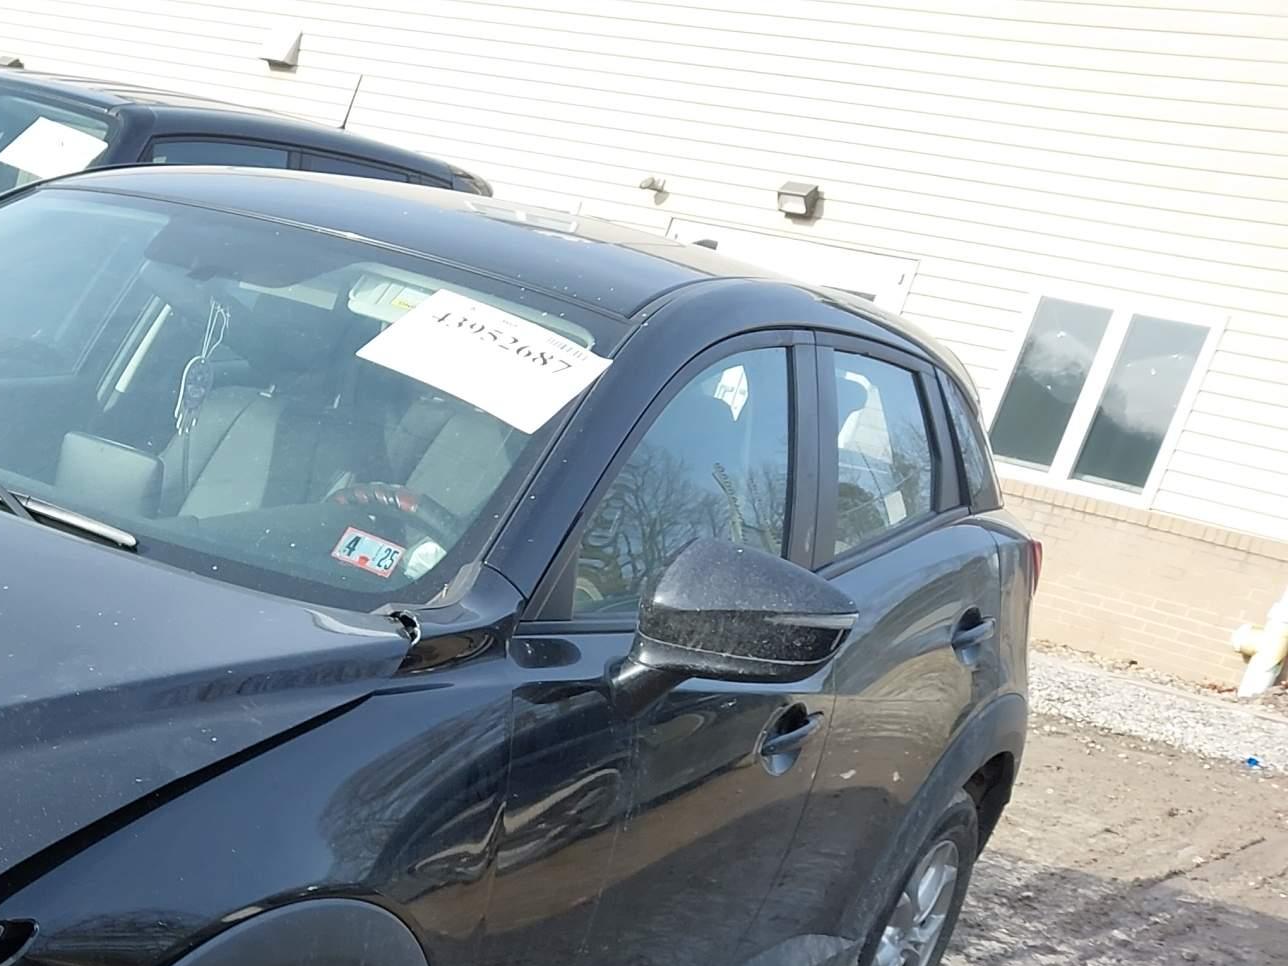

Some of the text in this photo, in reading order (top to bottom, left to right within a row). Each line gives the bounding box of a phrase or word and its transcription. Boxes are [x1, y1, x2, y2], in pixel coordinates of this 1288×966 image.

[431, 312, 573, 374] 43952687
[343, 535, 400, 570] 4 25
